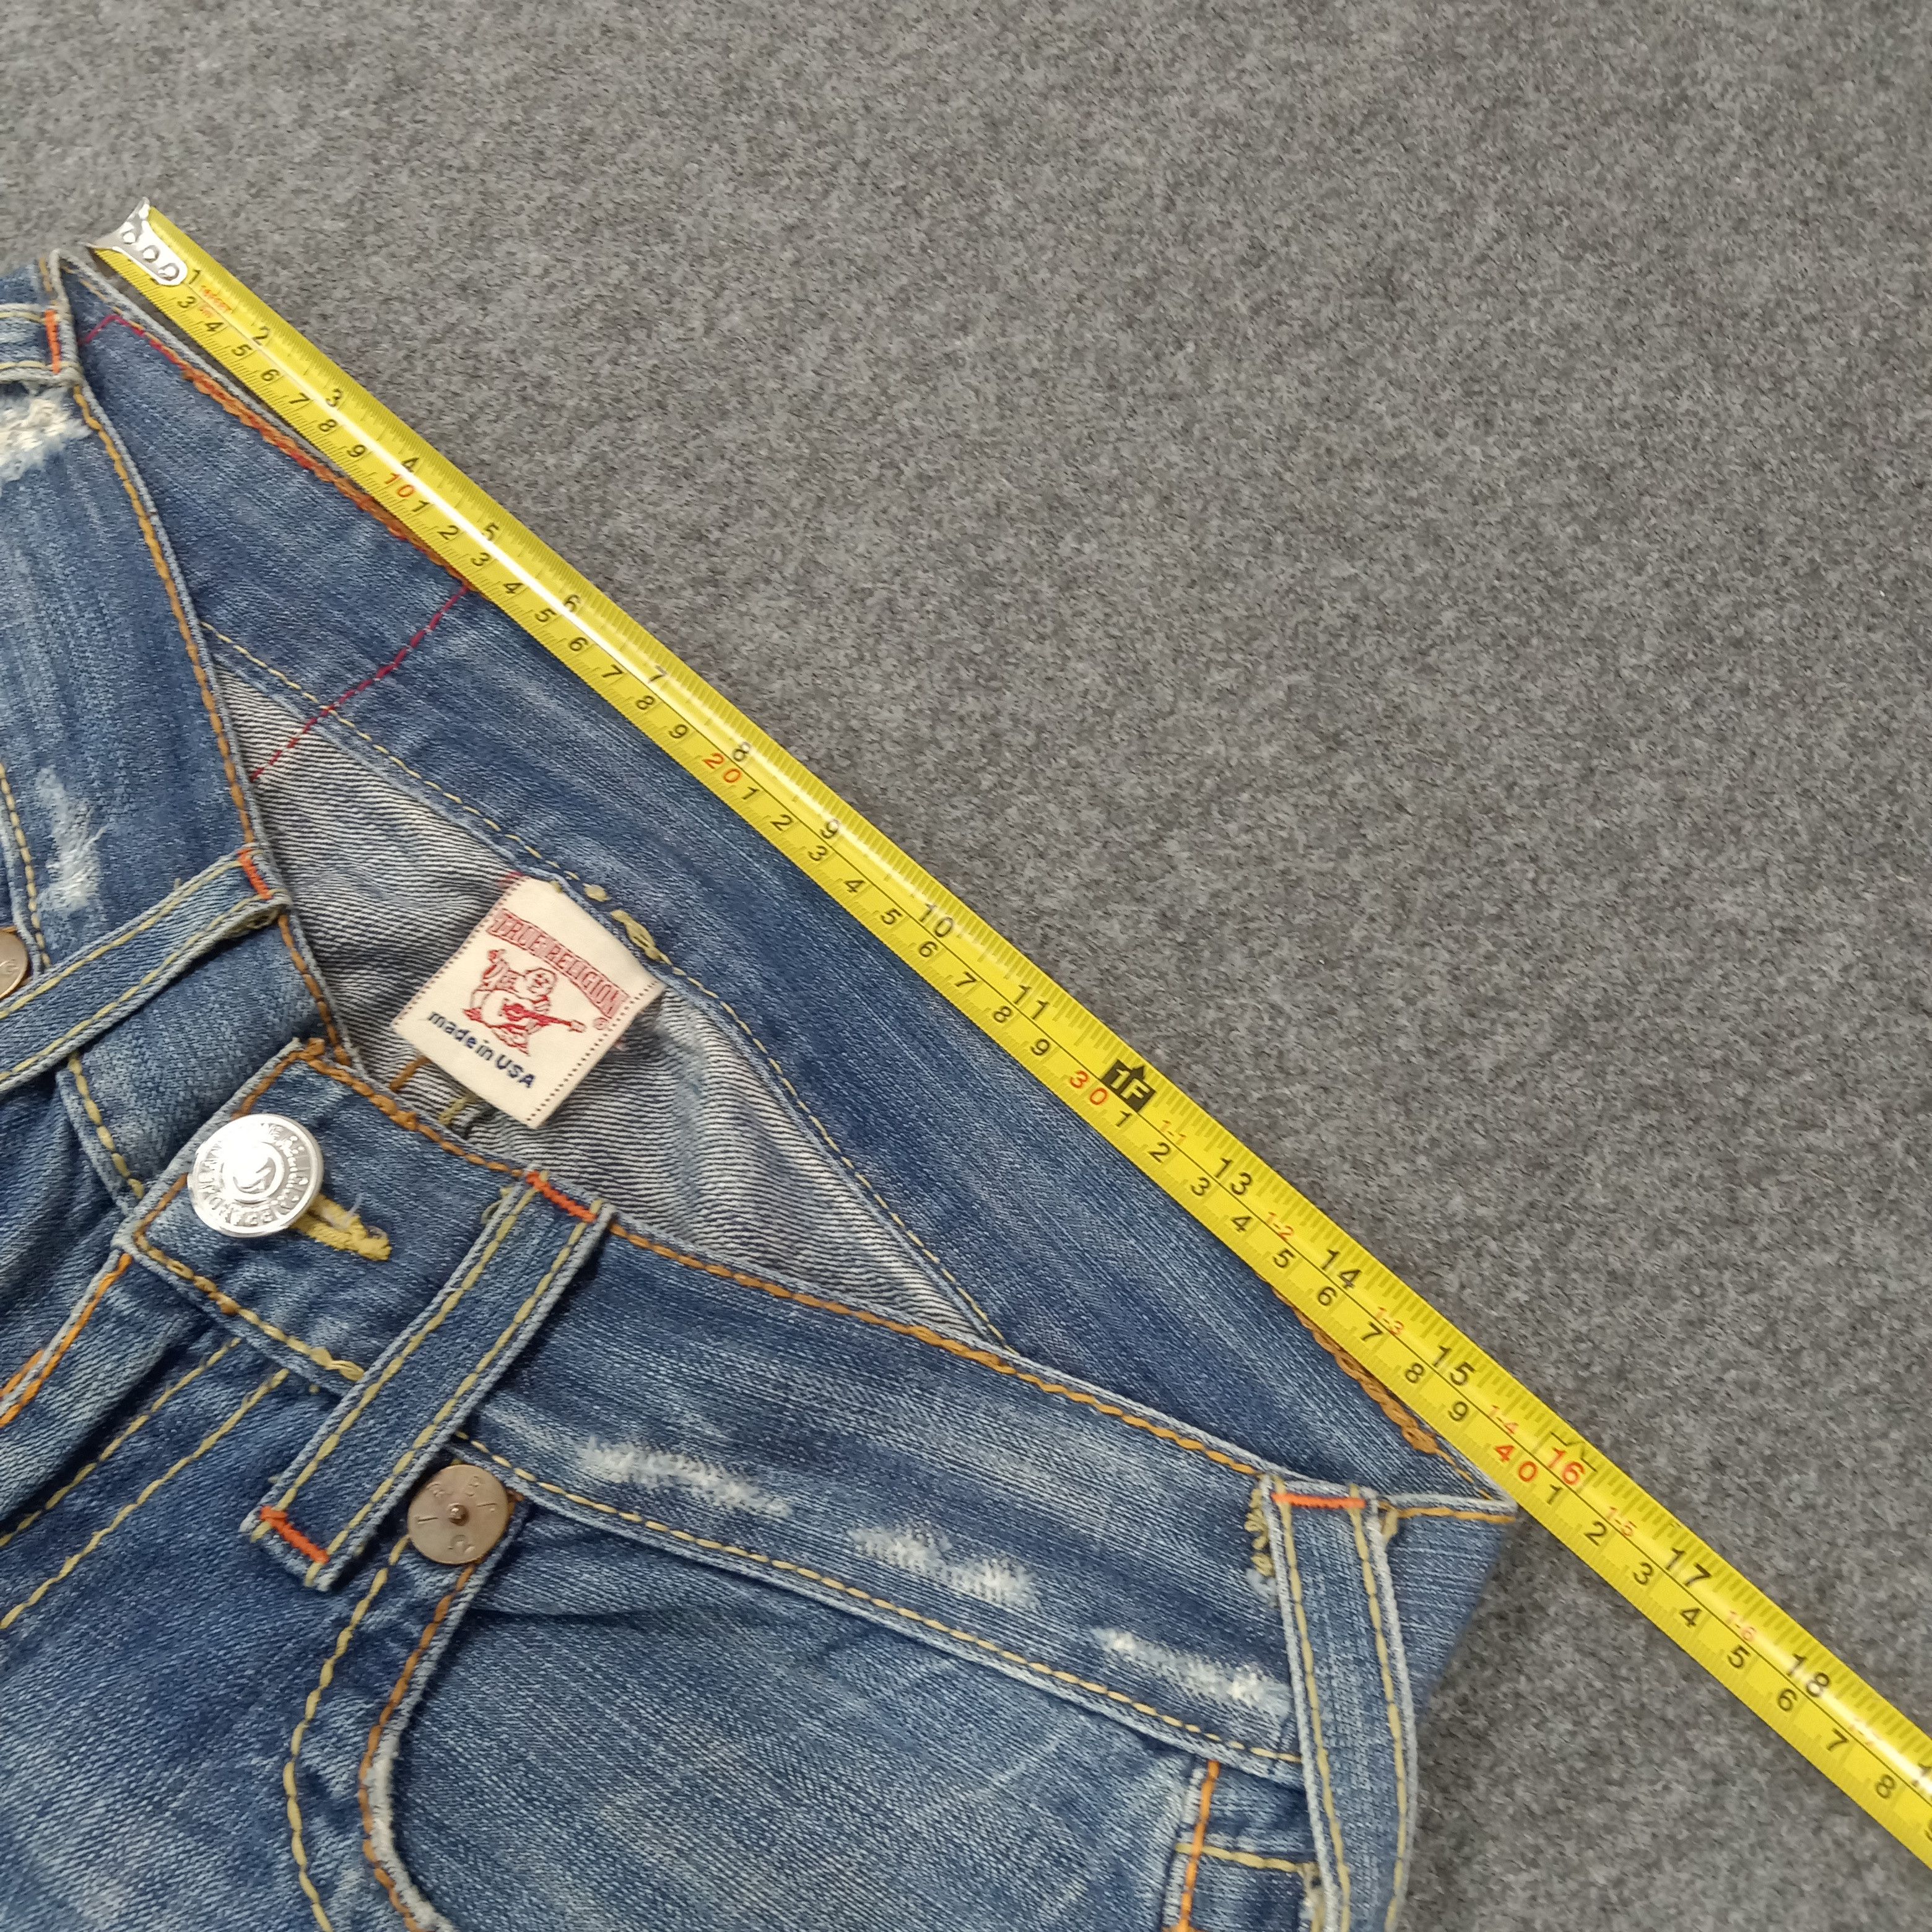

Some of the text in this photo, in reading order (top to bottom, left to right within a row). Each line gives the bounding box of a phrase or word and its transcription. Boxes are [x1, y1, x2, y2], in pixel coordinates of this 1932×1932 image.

[177, 296, 197, 308] 3
[206, 322, 222, 332] 4
[232, 344, 252, 356] 5
[261, 368, 280, 381] 6
[289, 392, 310, 405] 7
[318, 419, 337, 432] 8
[347, 444, 367, 458] 9
[384, 472, 415, 498] 10
[412, 500, 431, 512] 1
[437, 524, 459, 540] 2
[471, 552, 491, 567] 3
[503, 581, 523, 594] 4
[534, 608, 556, 622] 5
[568, 637, 588, 651] 6
[602, 664, 624, 679] 7
[636, 695, 655, 710] 8
[668, 724, 688, 739] 9
[703, 752, 742, 783] 20
[741, 786, 760, 800] 1
[770, 814, 793, 831] 2
[808, 845, 828, 861] 3
[844, 879, 864, 893] 4
[881, 908, 903, 925] 5
[918, 941, 938, 958] 6
[954, 971, 977, 988] 7
[993, 1006, 1013, 1023] 8
[1030, 1038, 1050, 1056] 9
[1070, 1070, 1108, 1106] 30
[1116, 1110, 1132, 1128] 1
[1149, 1142, 1170, 1163] 2
[1190, 1177, 1211, 1196] 3
[1230, 1215, 1252, 1232] 4
[1273, 1248, 1295, 1268] 5
[1317, 1286, 1338, 1307] 6
[1360, 1321, 1383, 1341] 7
[1404, 1362, 1425, 1383] 8
[1448, 1401, 1468, 1422] 9
[1494, 1445, 1538, 1482] 40
[1546, 1484, 1564, 1505] 1
[1585, 1520, 1608, 1546] 2
[1633, 1562, 1654, 1585] 3
[1679, 1608, 1702, 1628] 4
[1727, 1645, 1751, 1669] 5
[1777, 1688, 1798, 1712] 6
[1827, 1728, 1849, 1752] 7
[1875, 1774, 1896, 1799] 8
[189, 269, 1830, 1698] 1 2 3 4 5 6 7 8 9 10 11 1F 13 14 15 16 17 18
[427, 1011, 536, 1088] made in USA
